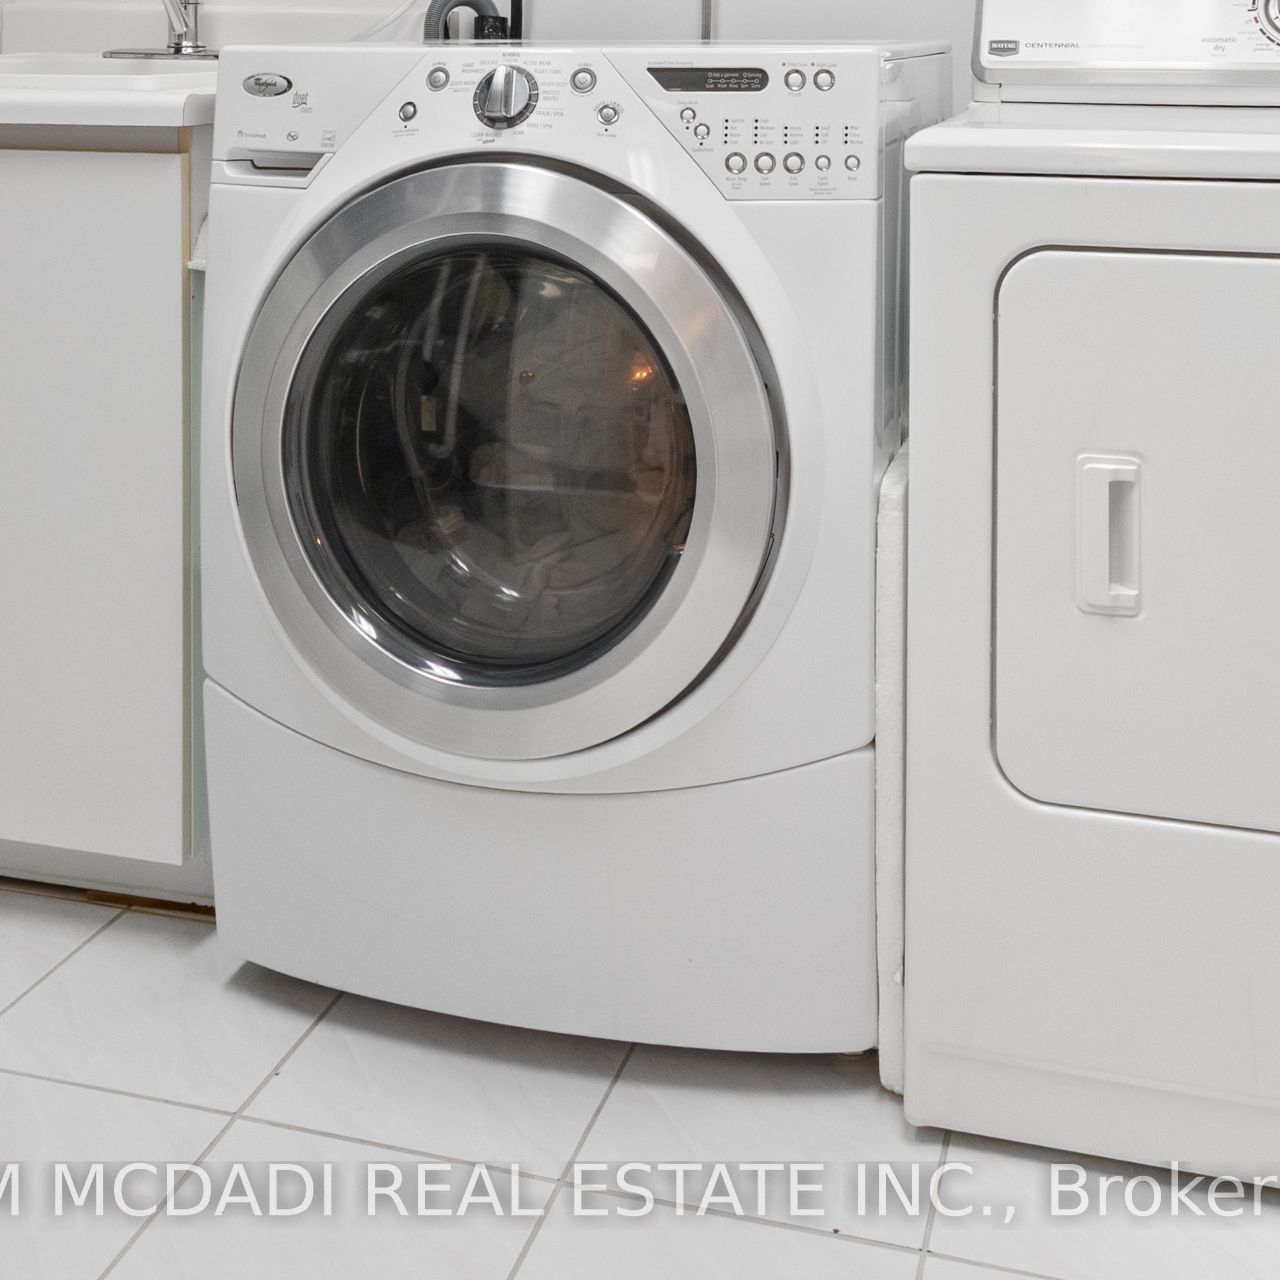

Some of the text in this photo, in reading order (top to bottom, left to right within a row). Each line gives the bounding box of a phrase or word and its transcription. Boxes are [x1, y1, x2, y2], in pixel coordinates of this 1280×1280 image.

[1201, 36, 1237, 44] automatic
[991, 42, 1017, 50] MAYTAG
[1024, 41, 1081, 49] CENTENNIAL
[1213, 44, 1225, 52] dry
